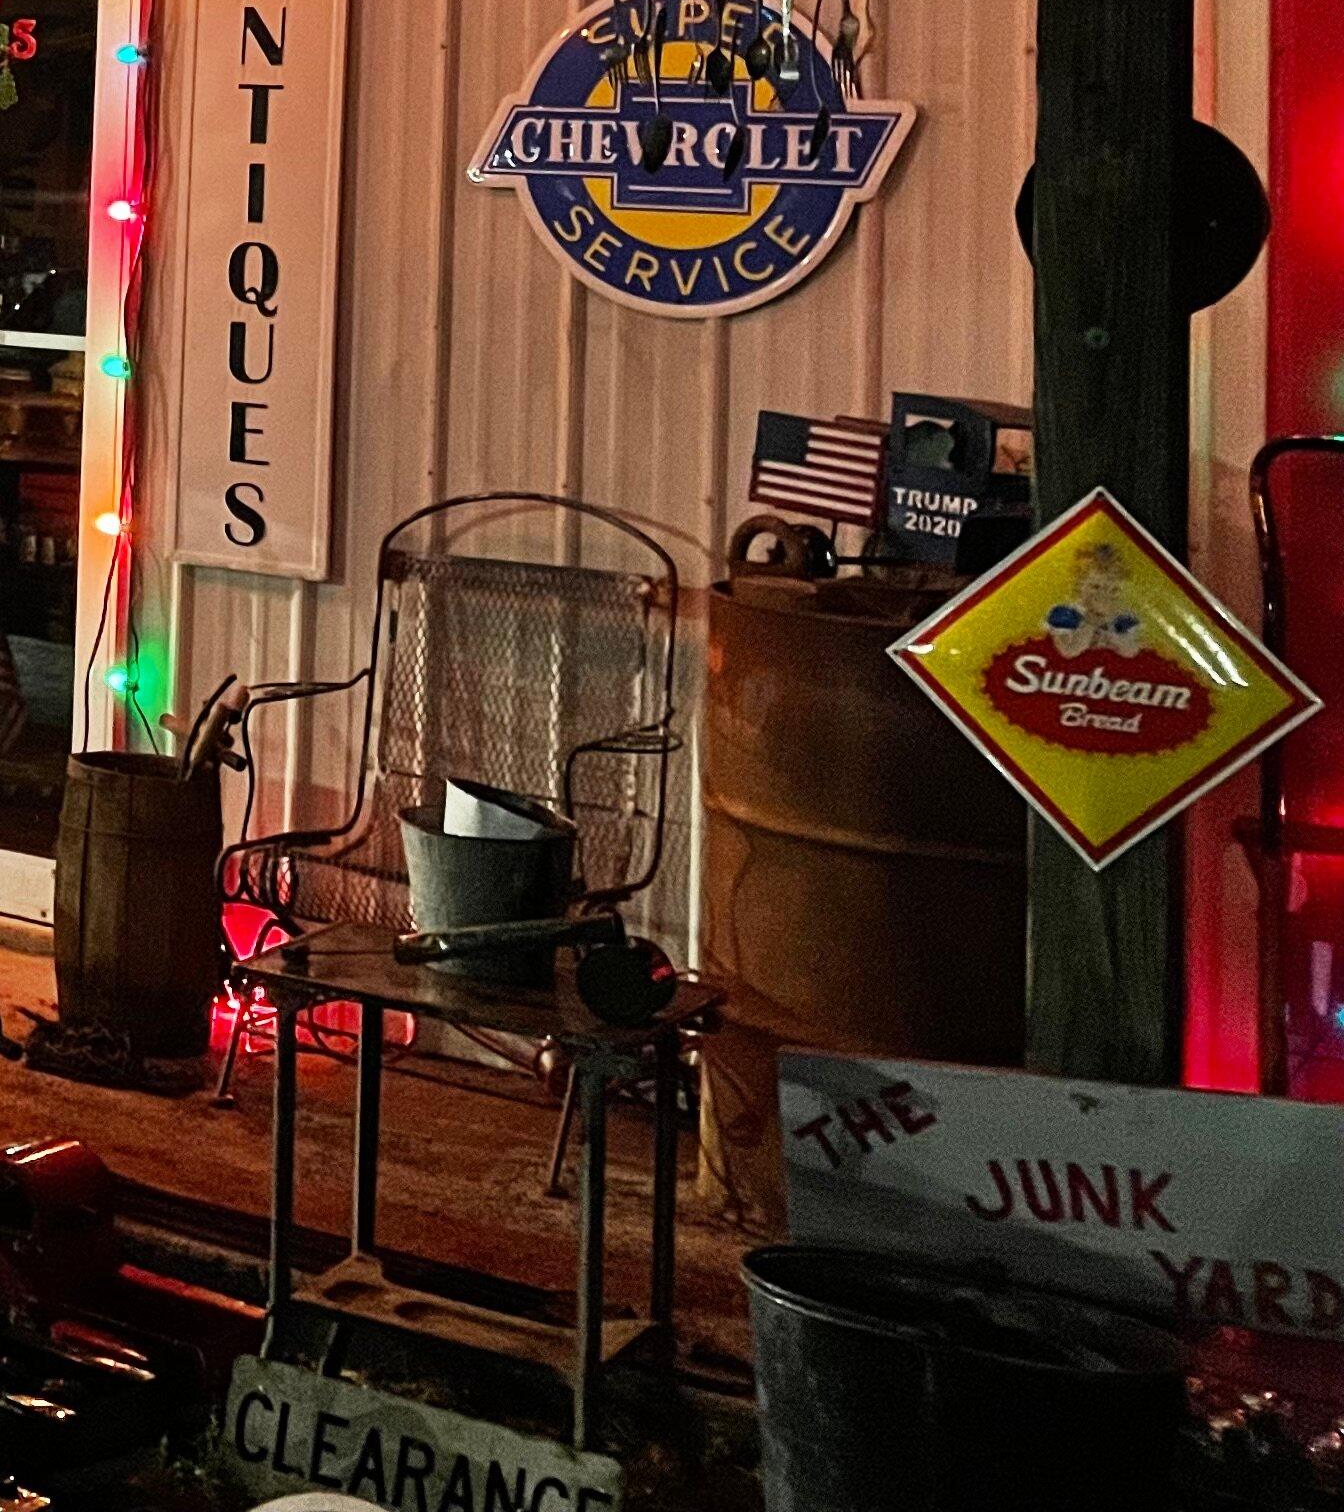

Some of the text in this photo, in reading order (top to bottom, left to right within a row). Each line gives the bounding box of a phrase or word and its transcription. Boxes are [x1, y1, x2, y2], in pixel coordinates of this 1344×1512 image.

[510, 116, 863, 173] CHEVROLET
[552, 204, 812, 297] SERVICE
[891, 486, 978, 516] TRUMP
[904, 511, 961, 538] 2020
[1005, 654, 1192, 710] Sunbeam
[1059, 702, 1144, 734] Bread
[792, 1081, 939, 1169] THE
[965, 1159, 1178, 1234] JUNK
[1150, 1249, 1344, 1332] YARD
